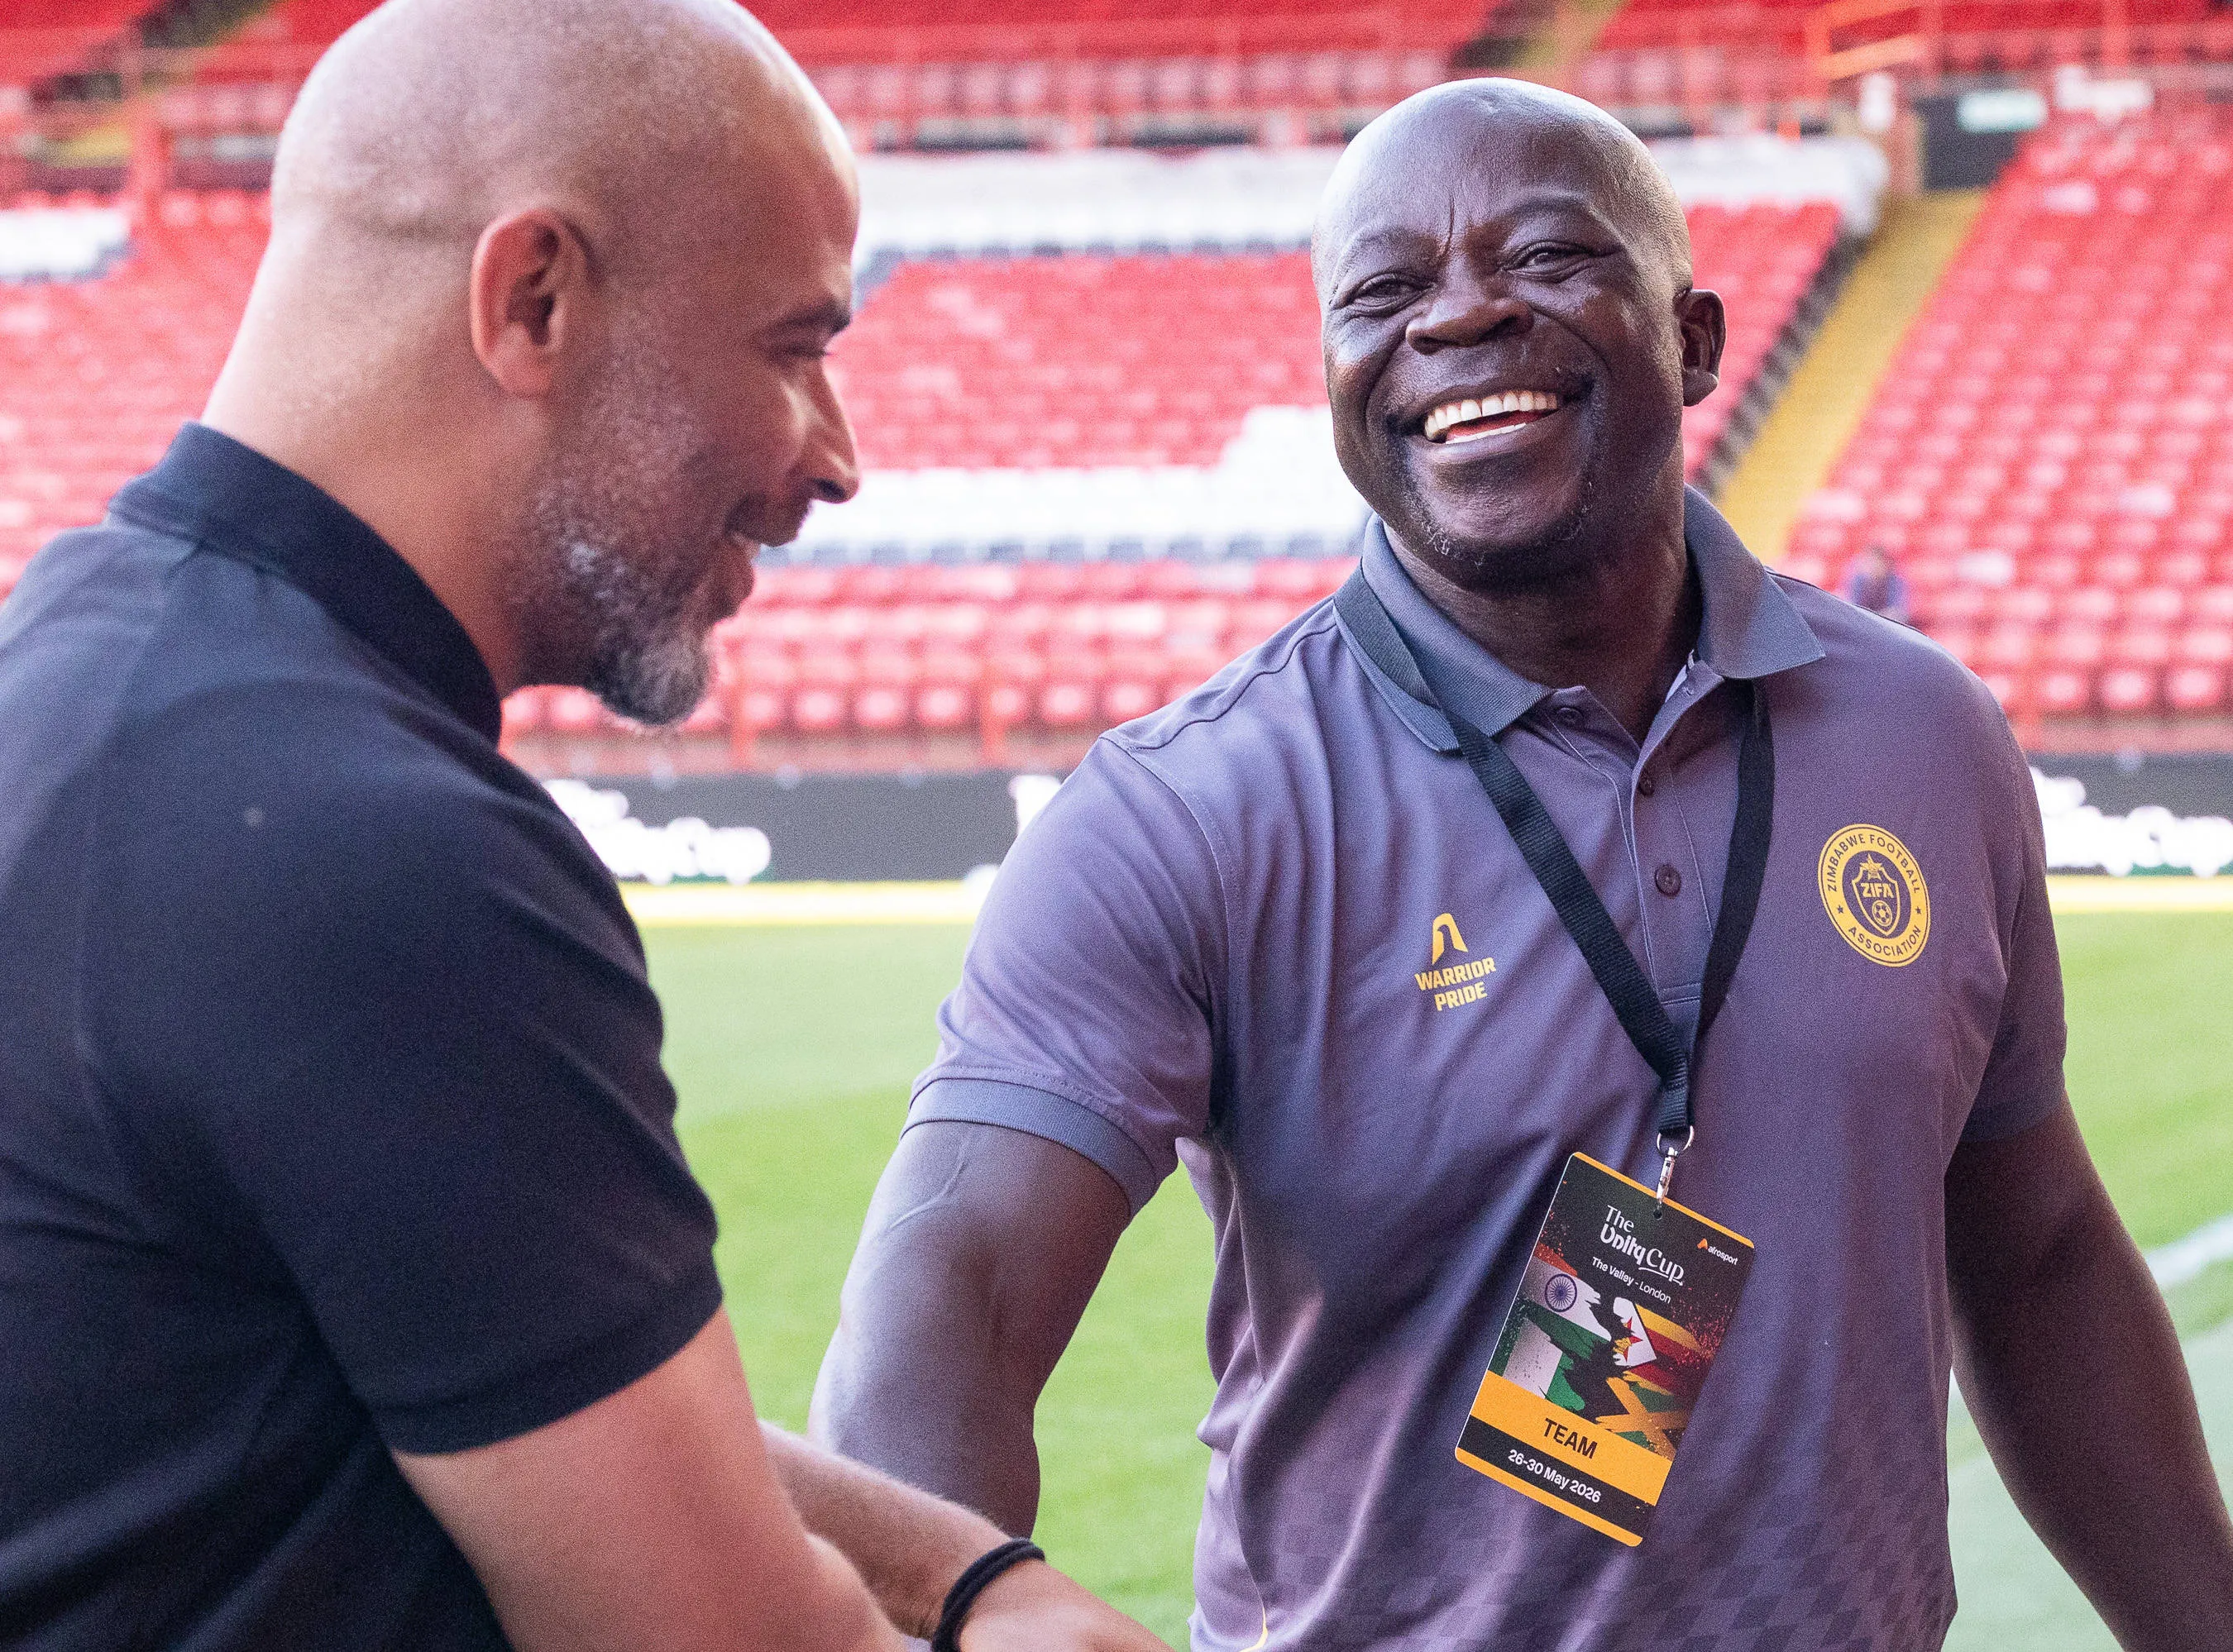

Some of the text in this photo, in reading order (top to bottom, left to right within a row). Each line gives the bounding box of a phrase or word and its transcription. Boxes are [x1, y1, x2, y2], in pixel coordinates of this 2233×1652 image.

[1829, 833, 1920, 894] ZIMBABWE FOOTBALL
[1861, 882, 1894, 899] ZIFA
[1848, 925, 1921, 957] ASSOCIATION
[1414, 957, 1496, 991] WARRIOR
[1434, 981, 1488, 1011] PRIDE
[1607, 1205, 1634, 1233] The
[1646, 1248, 1685, 1282] Cup
[1708, 1245, 1738, 1266] afrosport
[1592, 1256, 1609, 1272] The
[1609, 1265, 1635, 1286] Valley
[1639, 1282, 1671, 1304] London
[1543, 1417, 1598, 1459] TEAM
[1508, 1449, 1601, 1503] 26-30 May 2026
